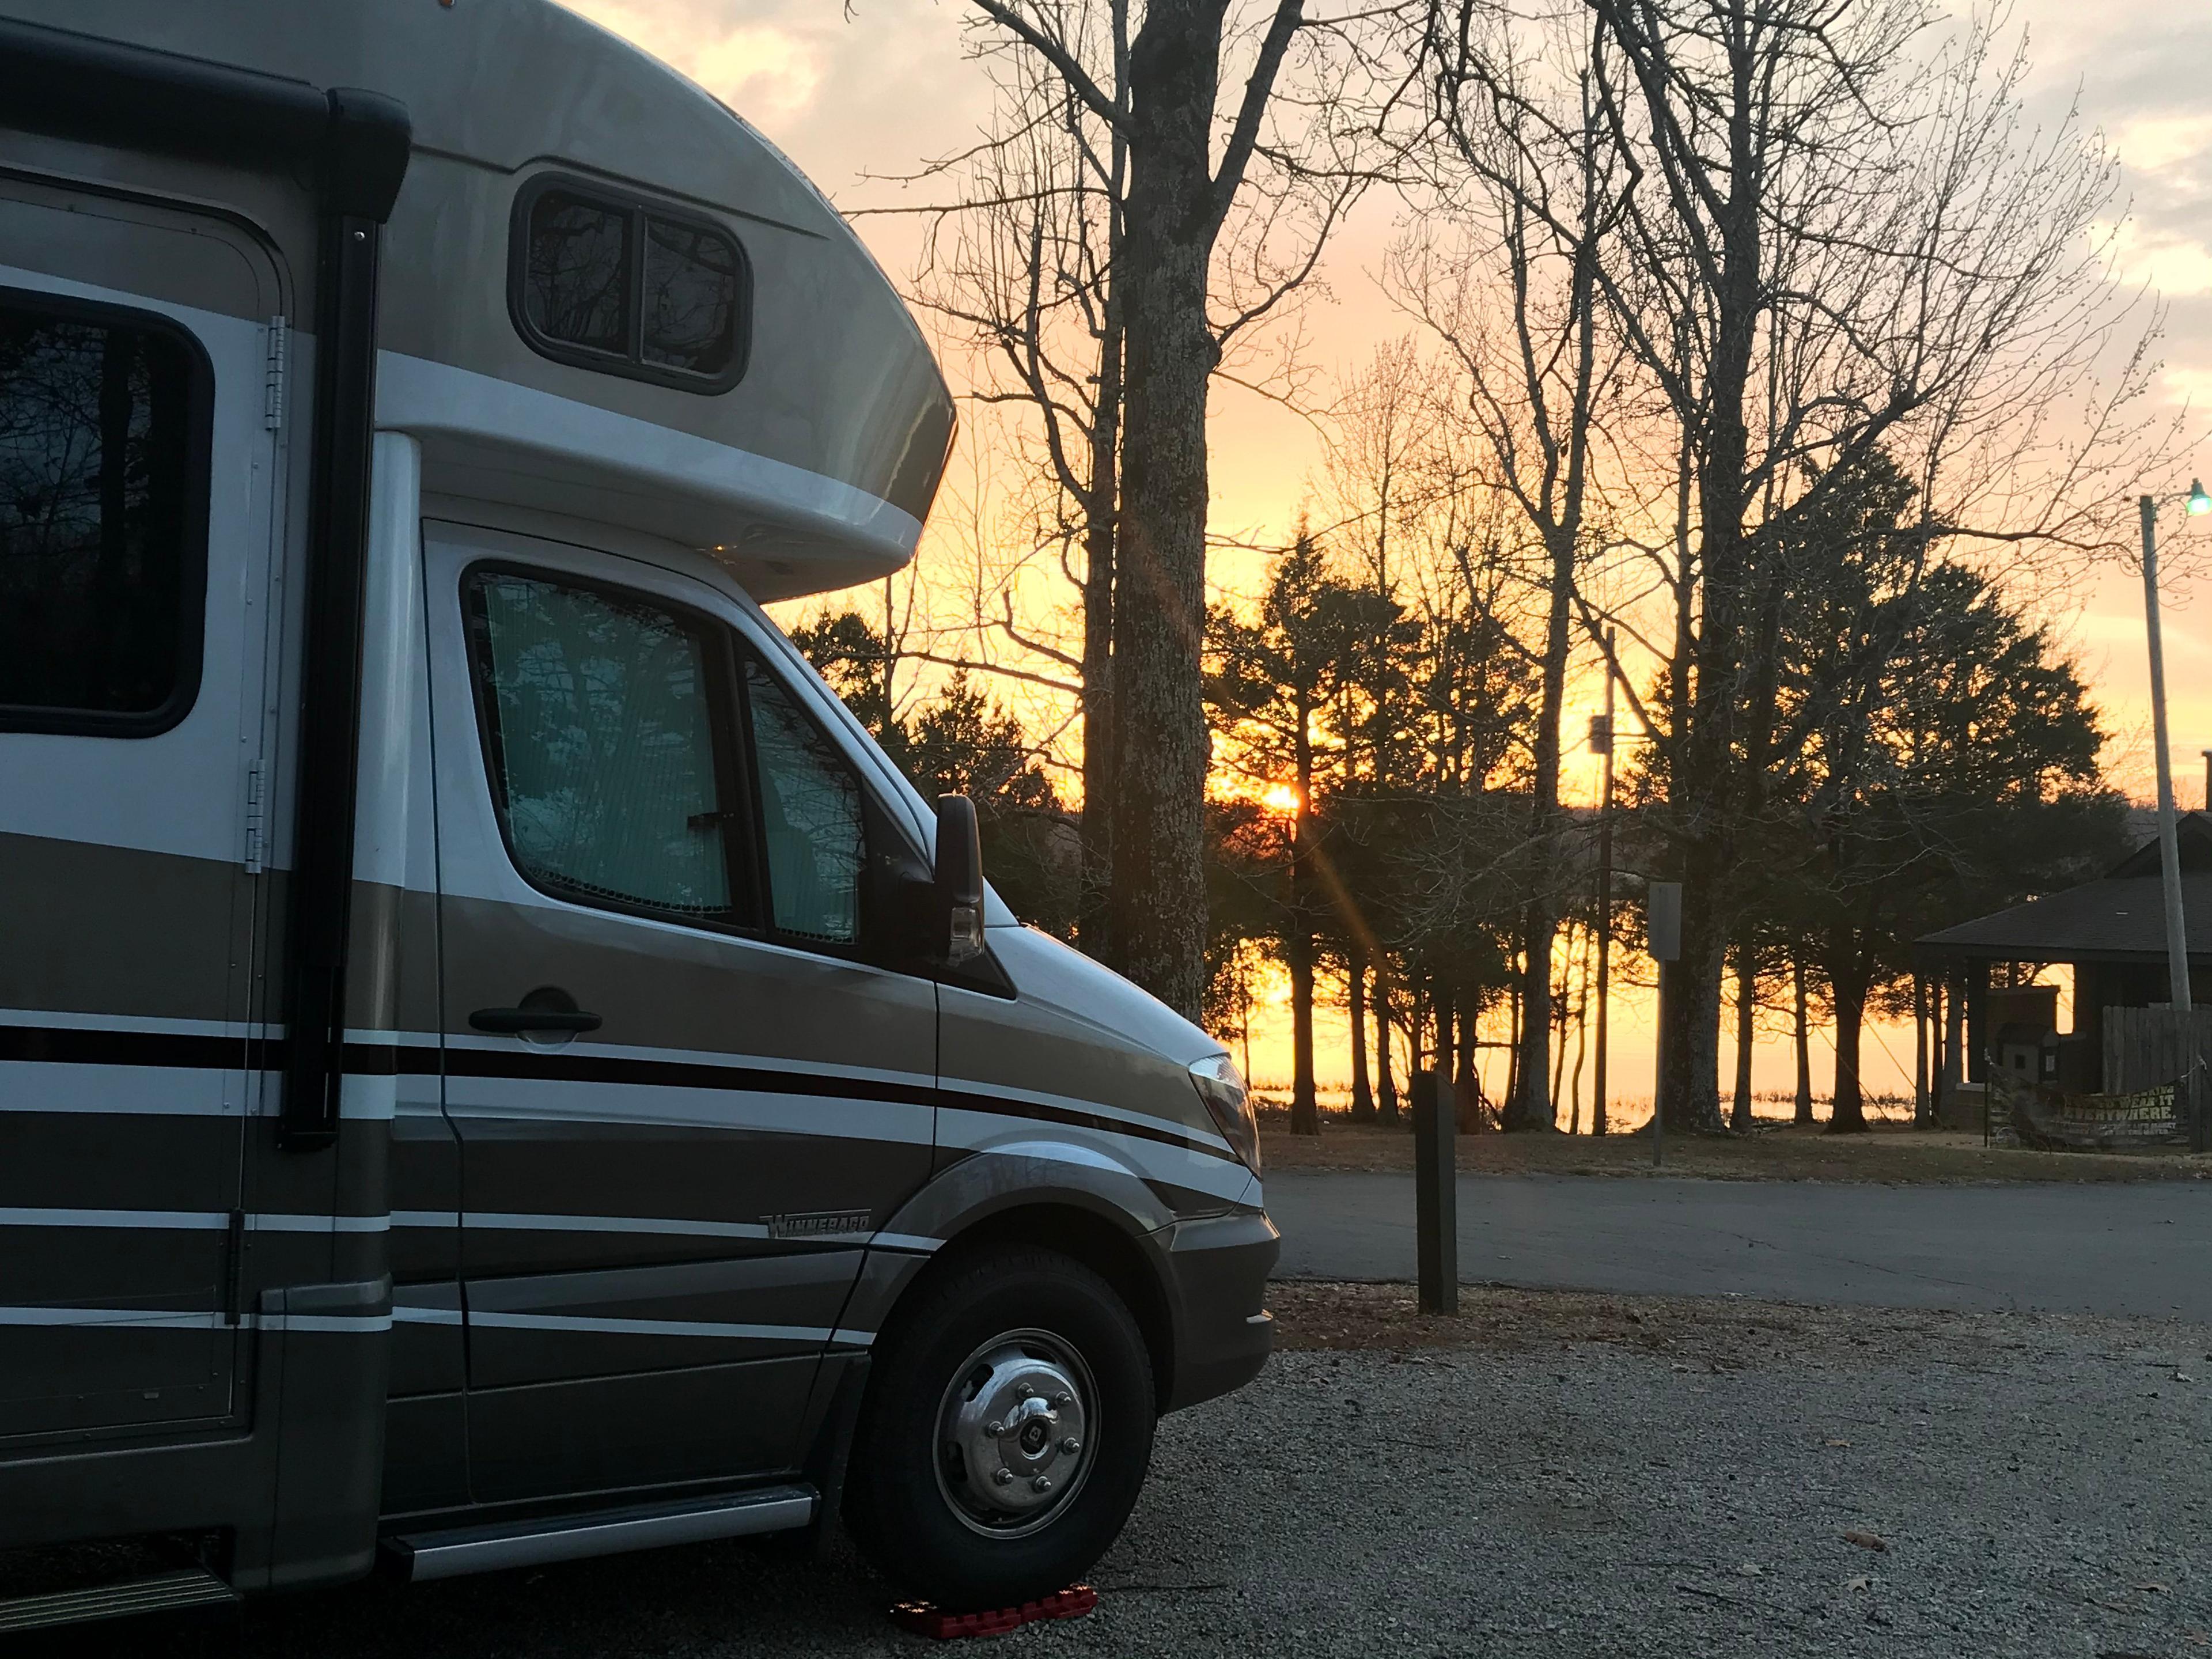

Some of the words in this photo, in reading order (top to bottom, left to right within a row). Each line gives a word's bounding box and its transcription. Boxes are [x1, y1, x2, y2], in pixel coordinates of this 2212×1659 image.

[2119, 1096, 2155, 1108] WEAR
[2160, 1094, 2175, 1105] IT
[762, 1211, 870, 1239] WINNEBAGO
